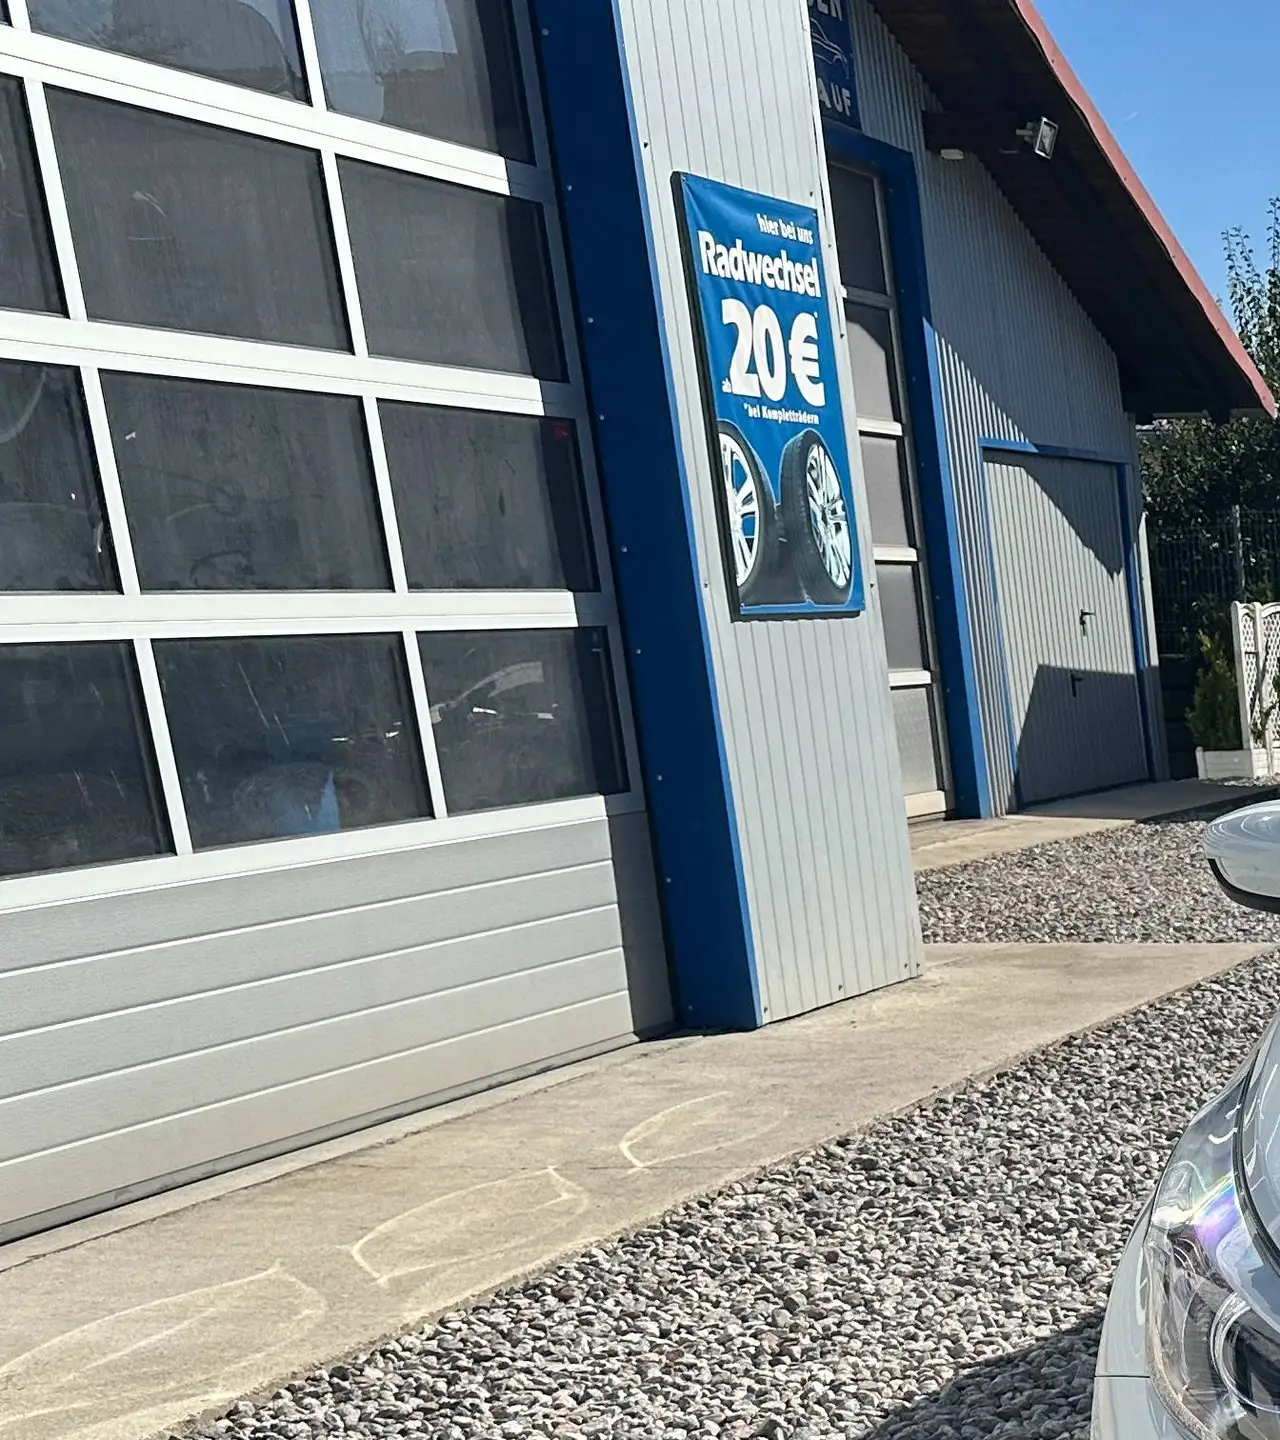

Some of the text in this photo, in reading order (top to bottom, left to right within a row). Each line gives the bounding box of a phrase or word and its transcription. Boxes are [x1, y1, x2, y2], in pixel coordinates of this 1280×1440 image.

[756, 213, 813, 245] hier bei uns
[698, 230, 821, 297] Radwechsel
